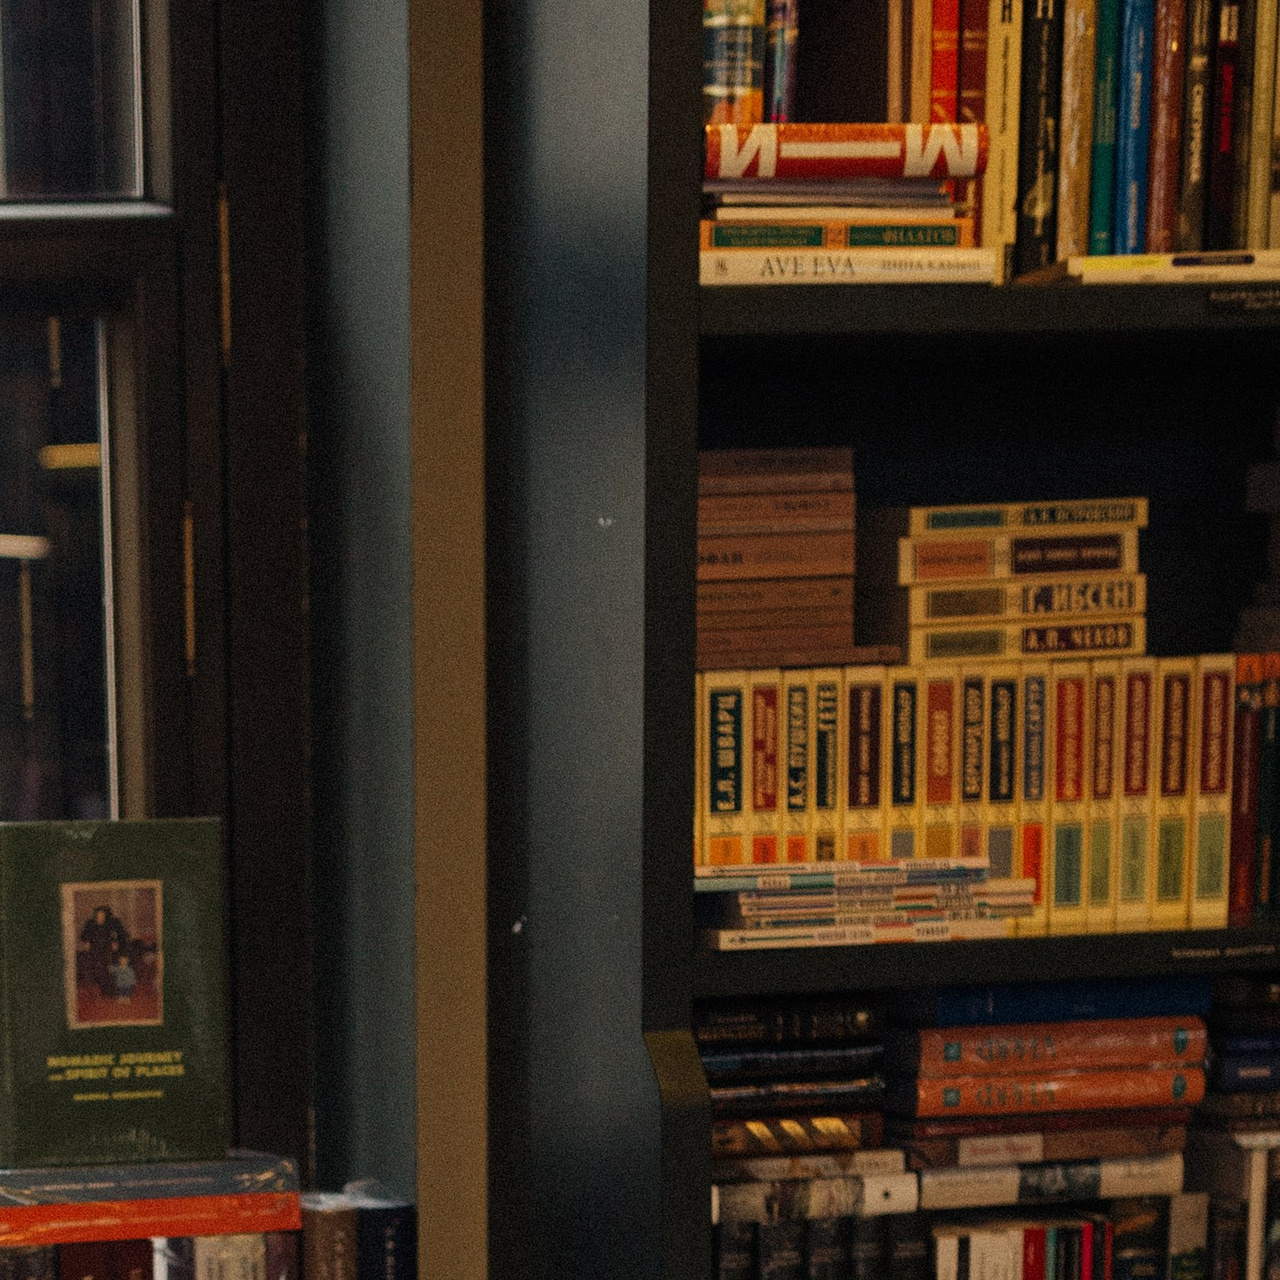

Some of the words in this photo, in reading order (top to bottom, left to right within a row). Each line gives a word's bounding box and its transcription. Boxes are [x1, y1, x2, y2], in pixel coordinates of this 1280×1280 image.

[761, 256, 806, 277] AVE
[813, 256, 855, 276] EVA
[1053, 582, 1133, 611] ИБСЕН
[1071, 626, 1128, 648] ЧЕХОВ
[717, 695, 737, 767] ШВАРЦ
[790, 691, 806, 768] ПУШКИН
